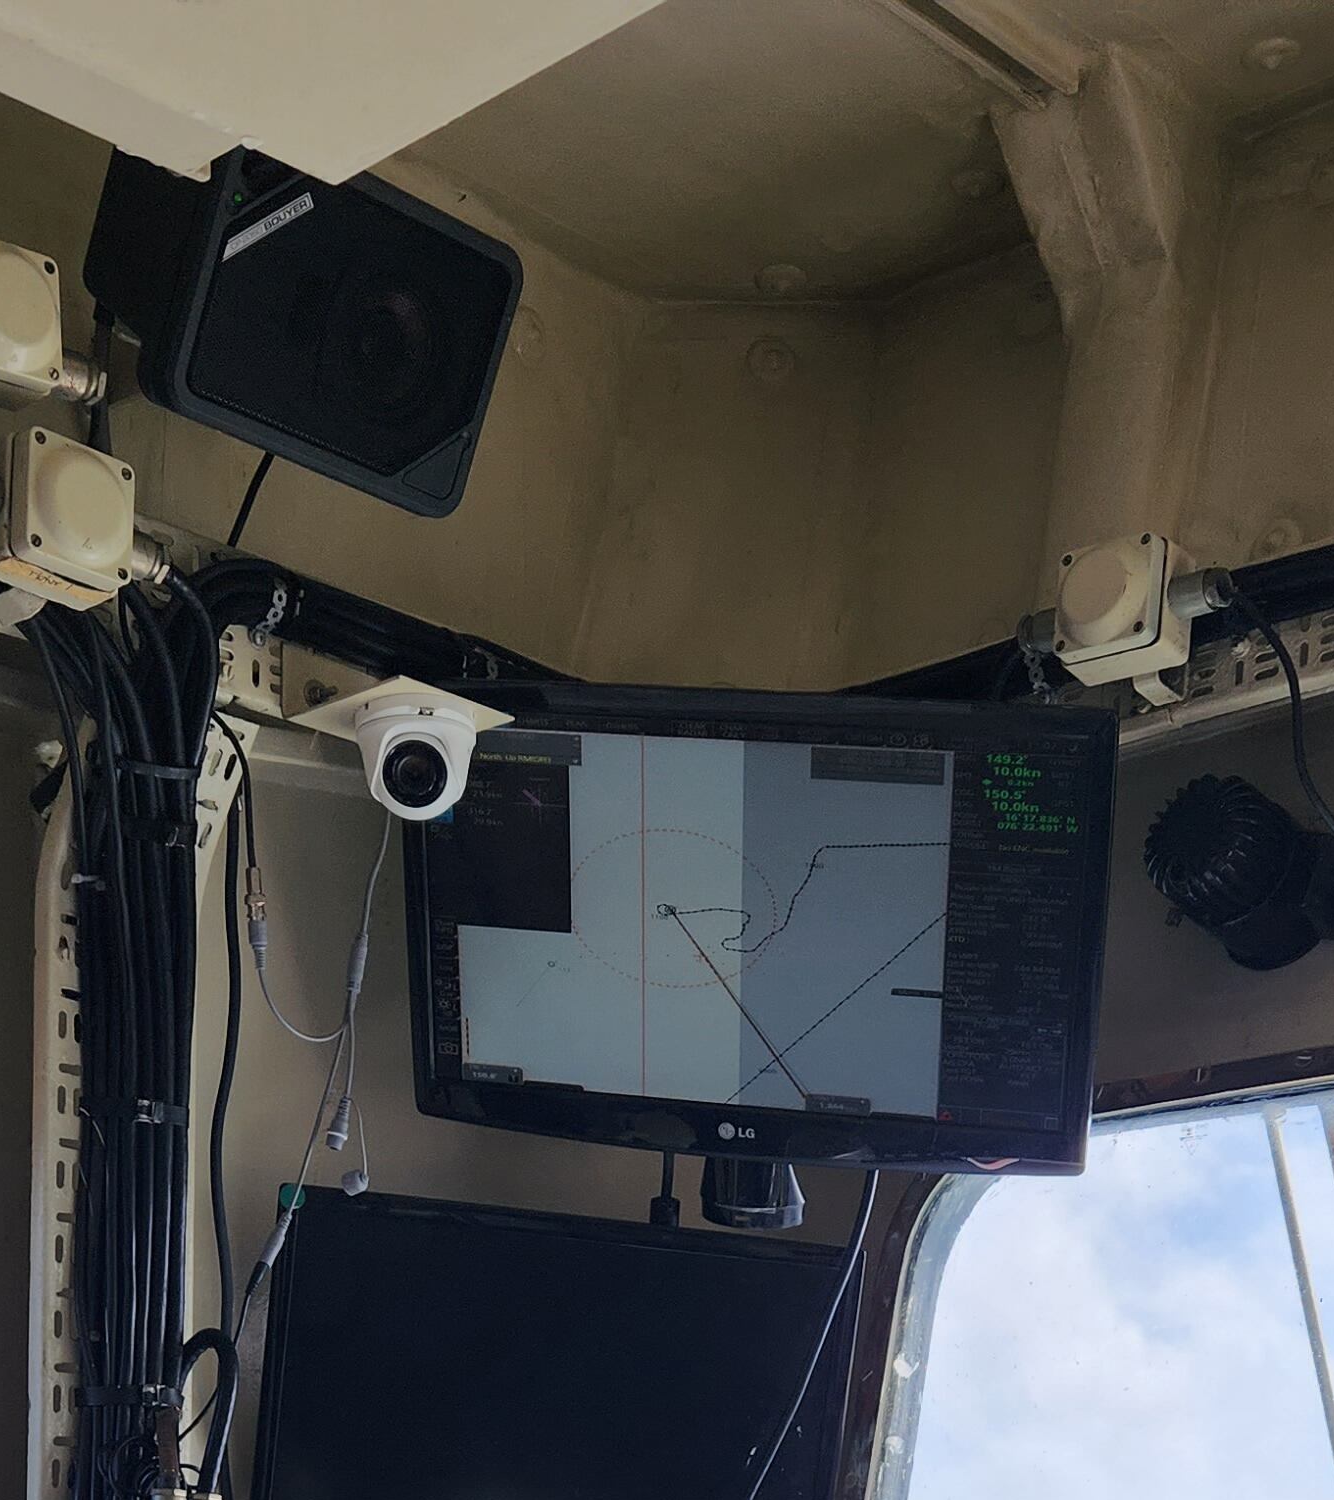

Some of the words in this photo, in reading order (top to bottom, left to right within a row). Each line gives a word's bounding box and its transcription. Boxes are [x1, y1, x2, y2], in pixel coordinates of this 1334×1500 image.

[263, 200, 308, 231] BOUYER
[992, 766, 1042, 778] 10.0kn
[991, 801, 1040, 813] 10.0kn
[738, 1126, 756, 1140] LG
